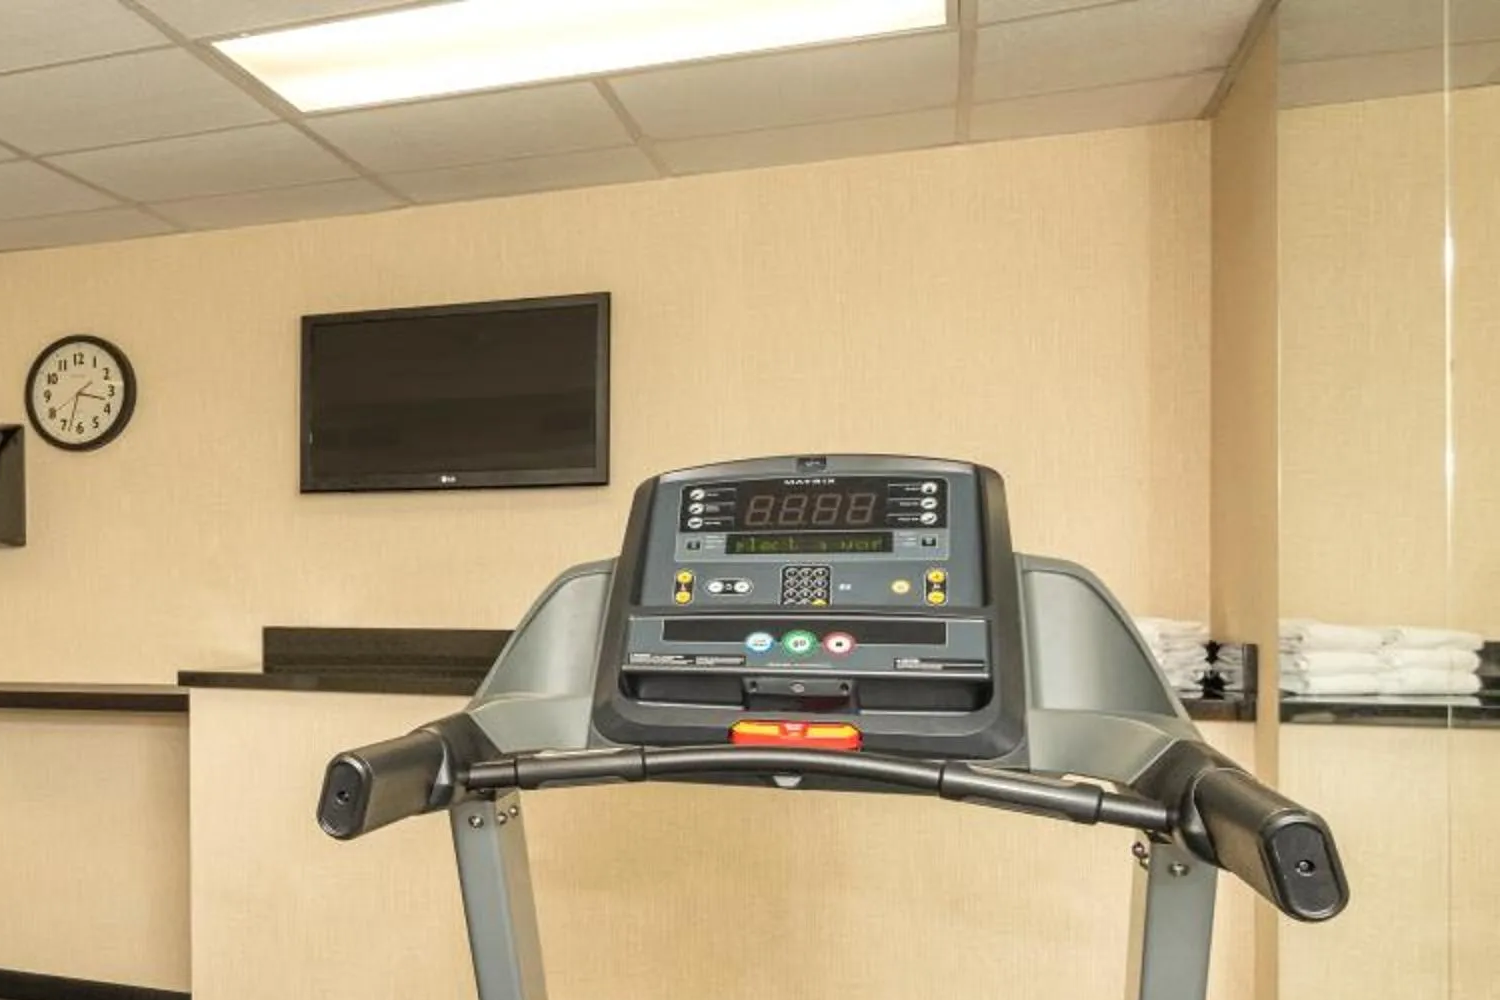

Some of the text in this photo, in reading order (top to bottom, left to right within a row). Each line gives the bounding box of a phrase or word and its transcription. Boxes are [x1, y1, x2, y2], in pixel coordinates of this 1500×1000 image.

[58, 359, 67, 371] 11
[73, 352, 85, 366] 12
[46, 372, 59, 385] 10
[102, 367, 110, 381] 2
[43, 389, 52, 402] 9
[107, 384, 115, 397] 3
[103, 402, 111, 415] 4
[60, 419, 67, 432] 7
[76, 422, 85, 434] 6
[92, 415, 99, 429] 5
